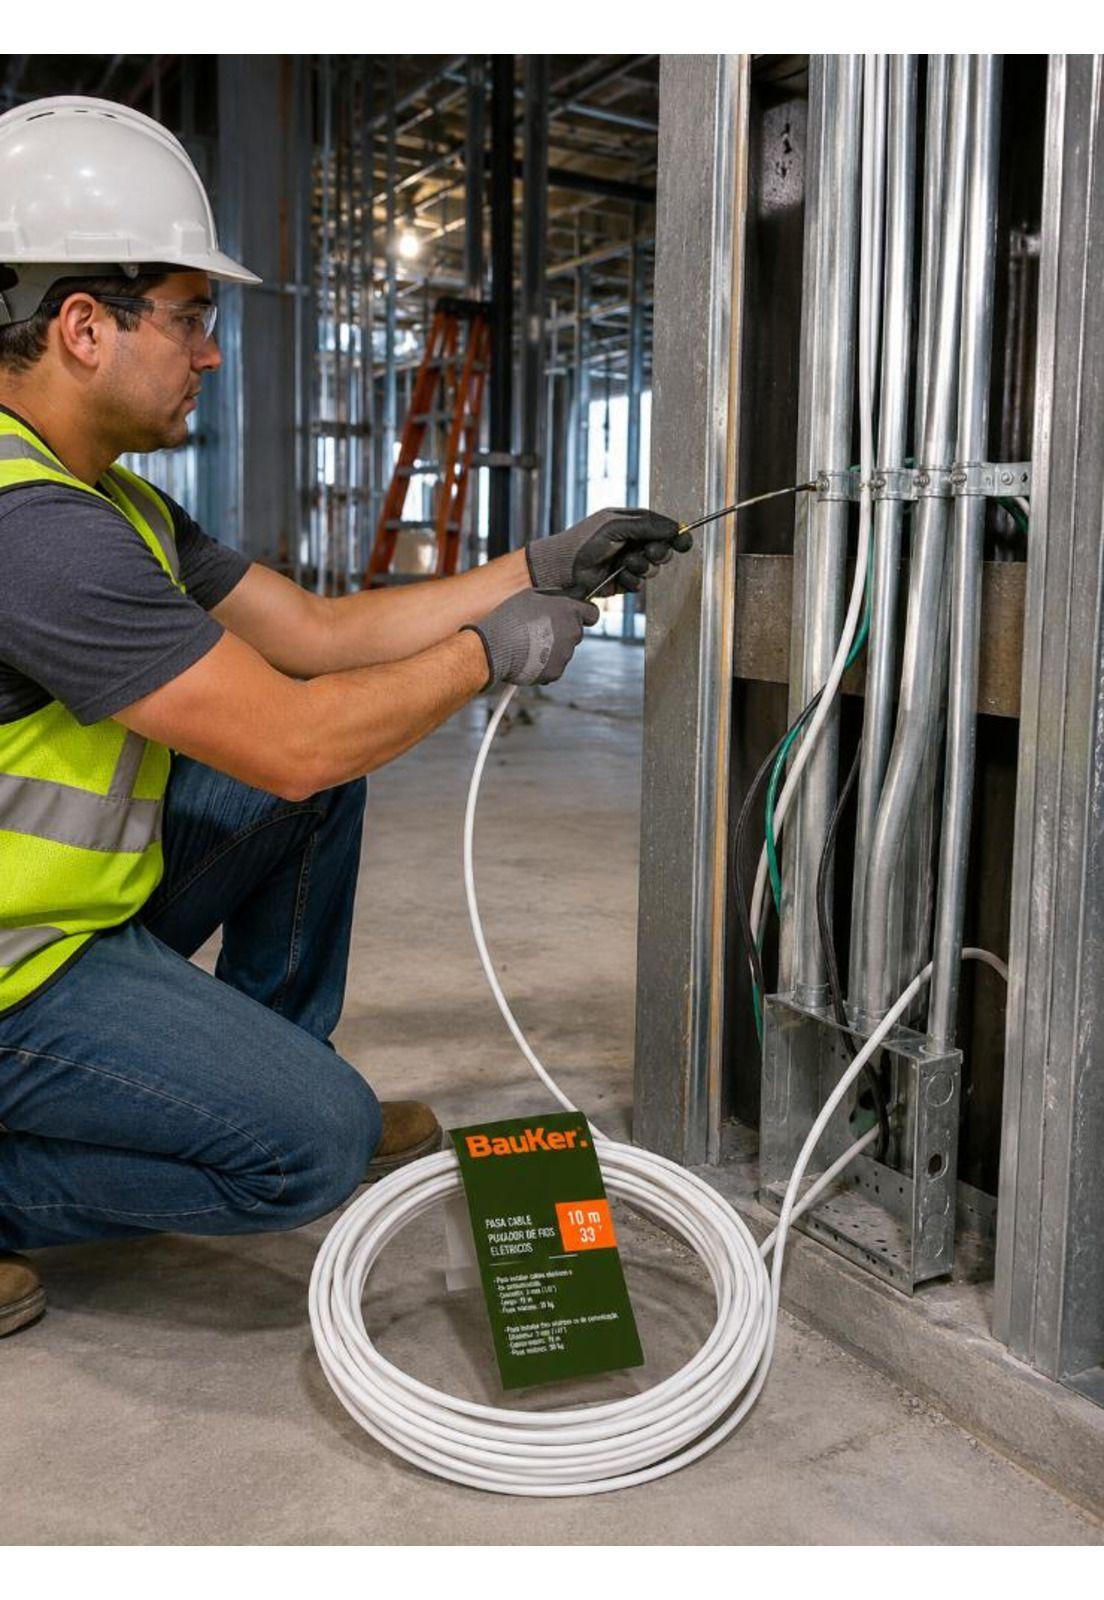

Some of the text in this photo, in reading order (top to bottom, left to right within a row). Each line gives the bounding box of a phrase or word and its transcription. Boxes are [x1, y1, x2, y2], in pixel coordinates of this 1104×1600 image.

[485, 1215, 533, 1229] PASA CABLE
[568, 1210, 601, 1225] 10 m
[526, 1229, 538, 1240] DE
